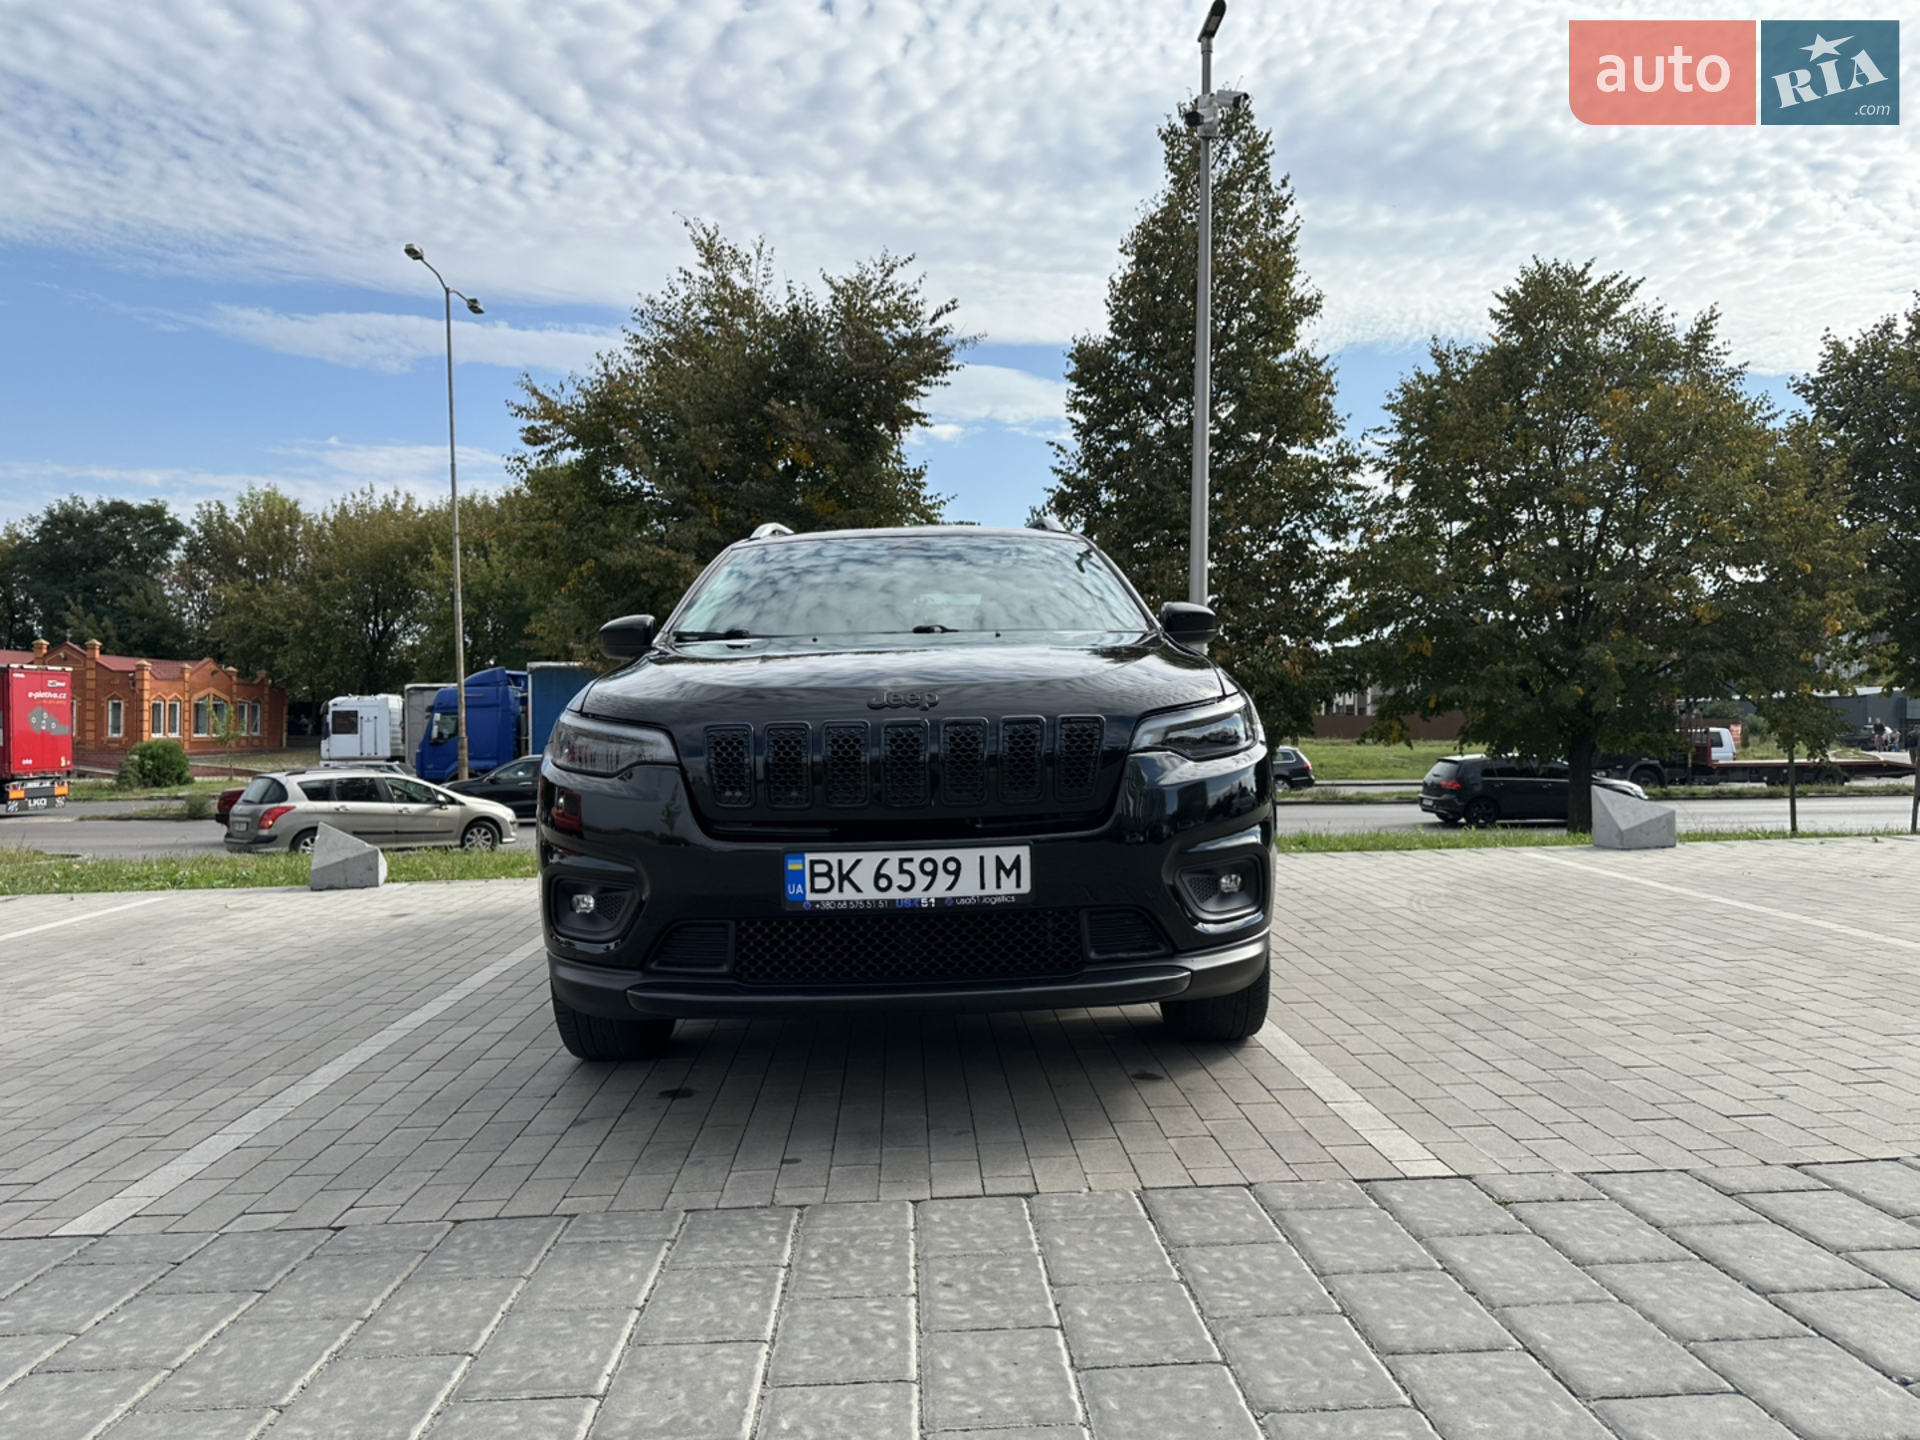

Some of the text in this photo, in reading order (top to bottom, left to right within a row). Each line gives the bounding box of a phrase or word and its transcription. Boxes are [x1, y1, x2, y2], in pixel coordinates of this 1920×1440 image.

[867, 689, 939, 711] Jeep
[809, 853, 1021, 893] BK 6599 IM
[788, 884, 804, 894] UA
